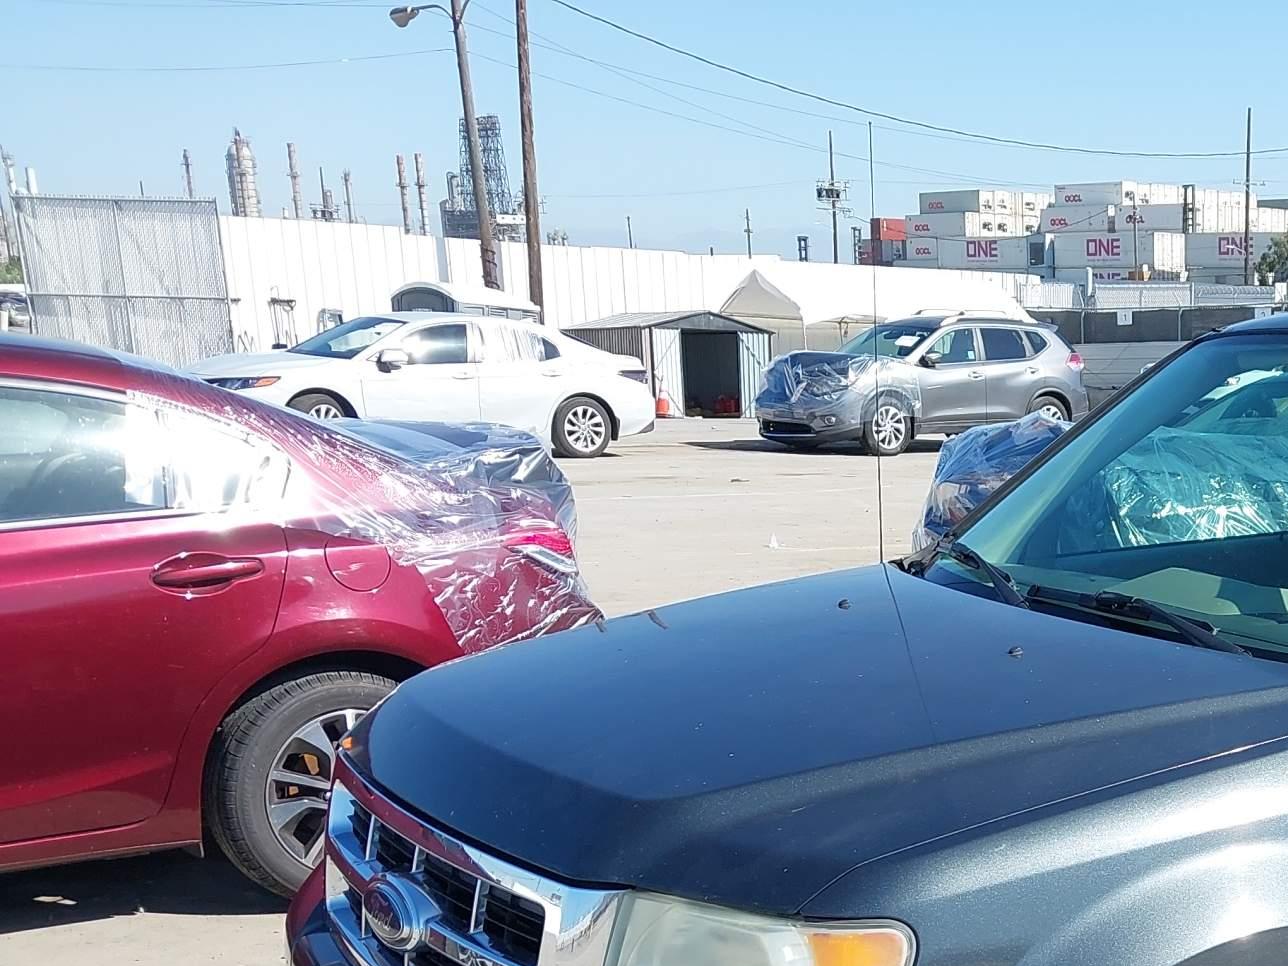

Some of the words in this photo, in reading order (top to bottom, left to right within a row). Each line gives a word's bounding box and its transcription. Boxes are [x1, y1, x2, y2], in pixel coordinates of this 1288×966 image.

[966, 240, 998, 257] ONE
[1086, 238, 1121, 257] ONE
[1218, 236, 1254, 256] ONE
